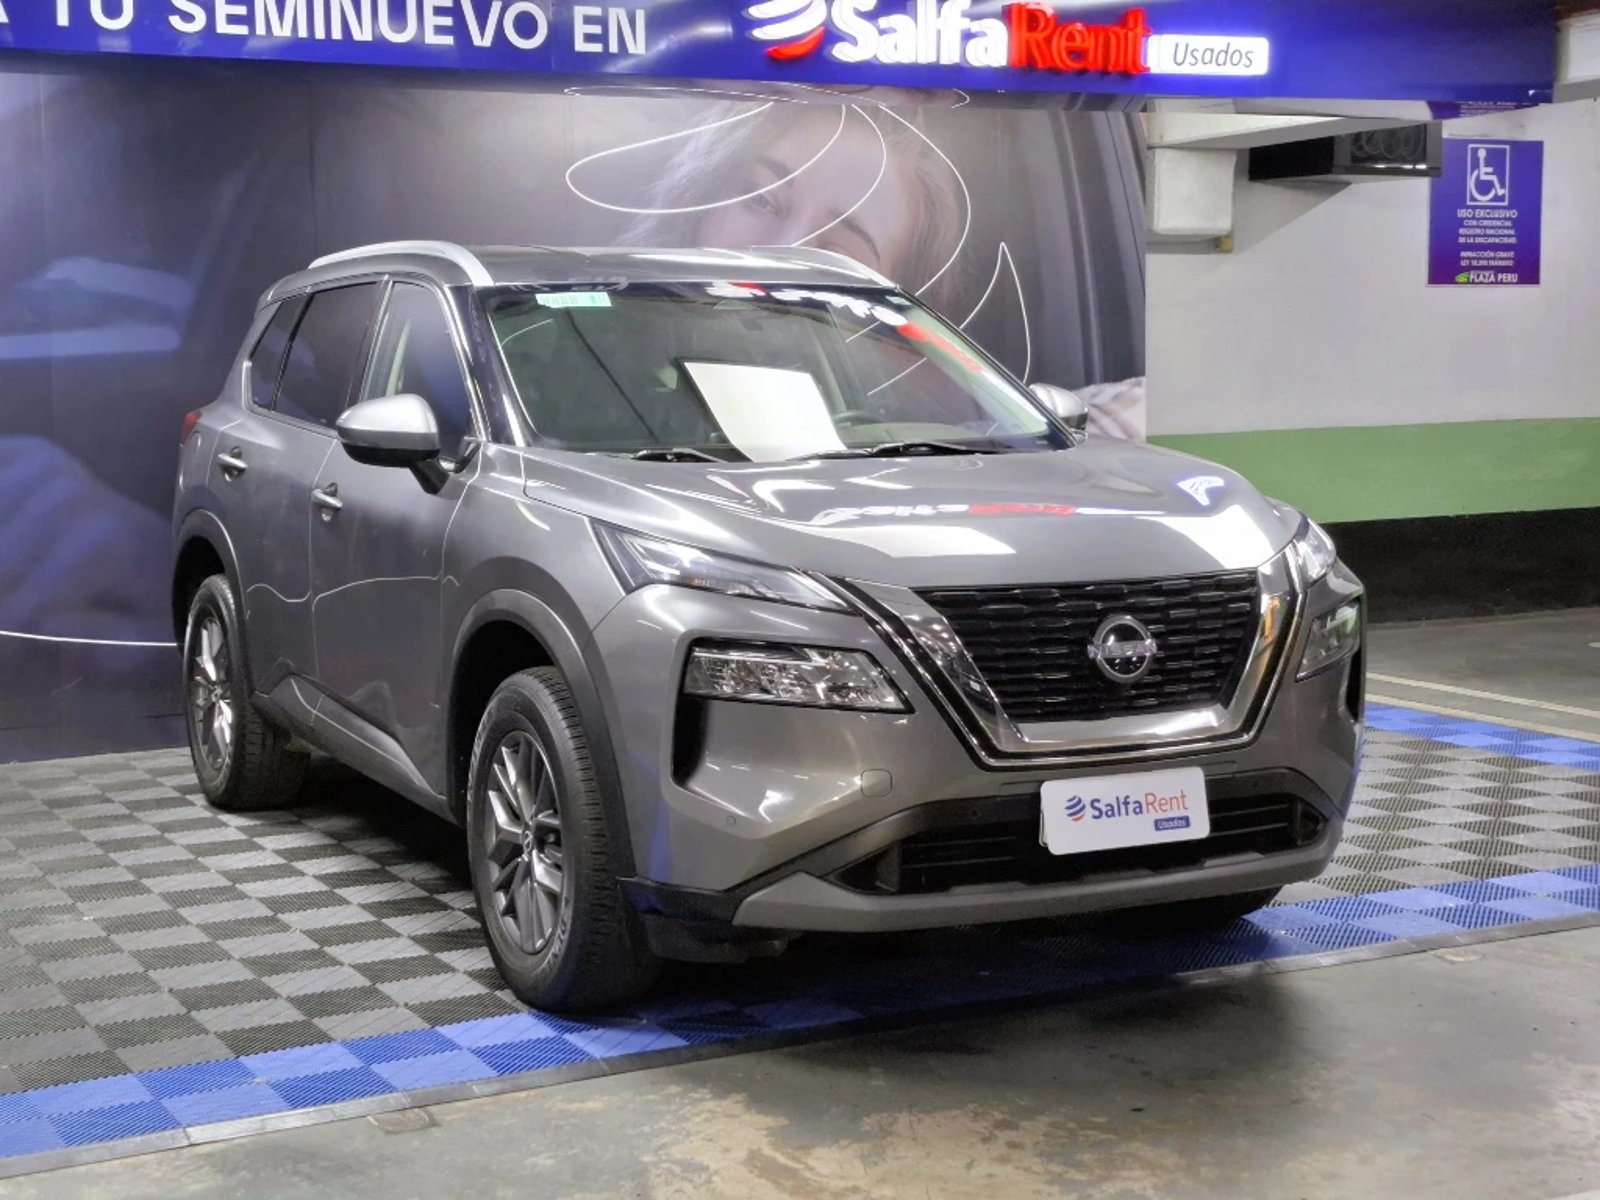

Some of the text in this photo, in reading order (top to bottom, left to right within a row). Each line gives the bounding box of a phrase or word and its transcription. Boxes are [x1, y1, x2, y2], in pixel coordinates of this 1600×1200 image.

[168, 0, 548, 50] SEMINUEVO
[573, 6, 647, 55] EN
[1170, 40, 1255, 69] Usados
[1457, 208, 1518, 218] USO EXCLUSIVO
[1469, 272, 1518, 283] PLAZA PERU
[1087, 640, 1157, 658] NISSAN
[1089, 789, 1189, 820] SalfaRent
